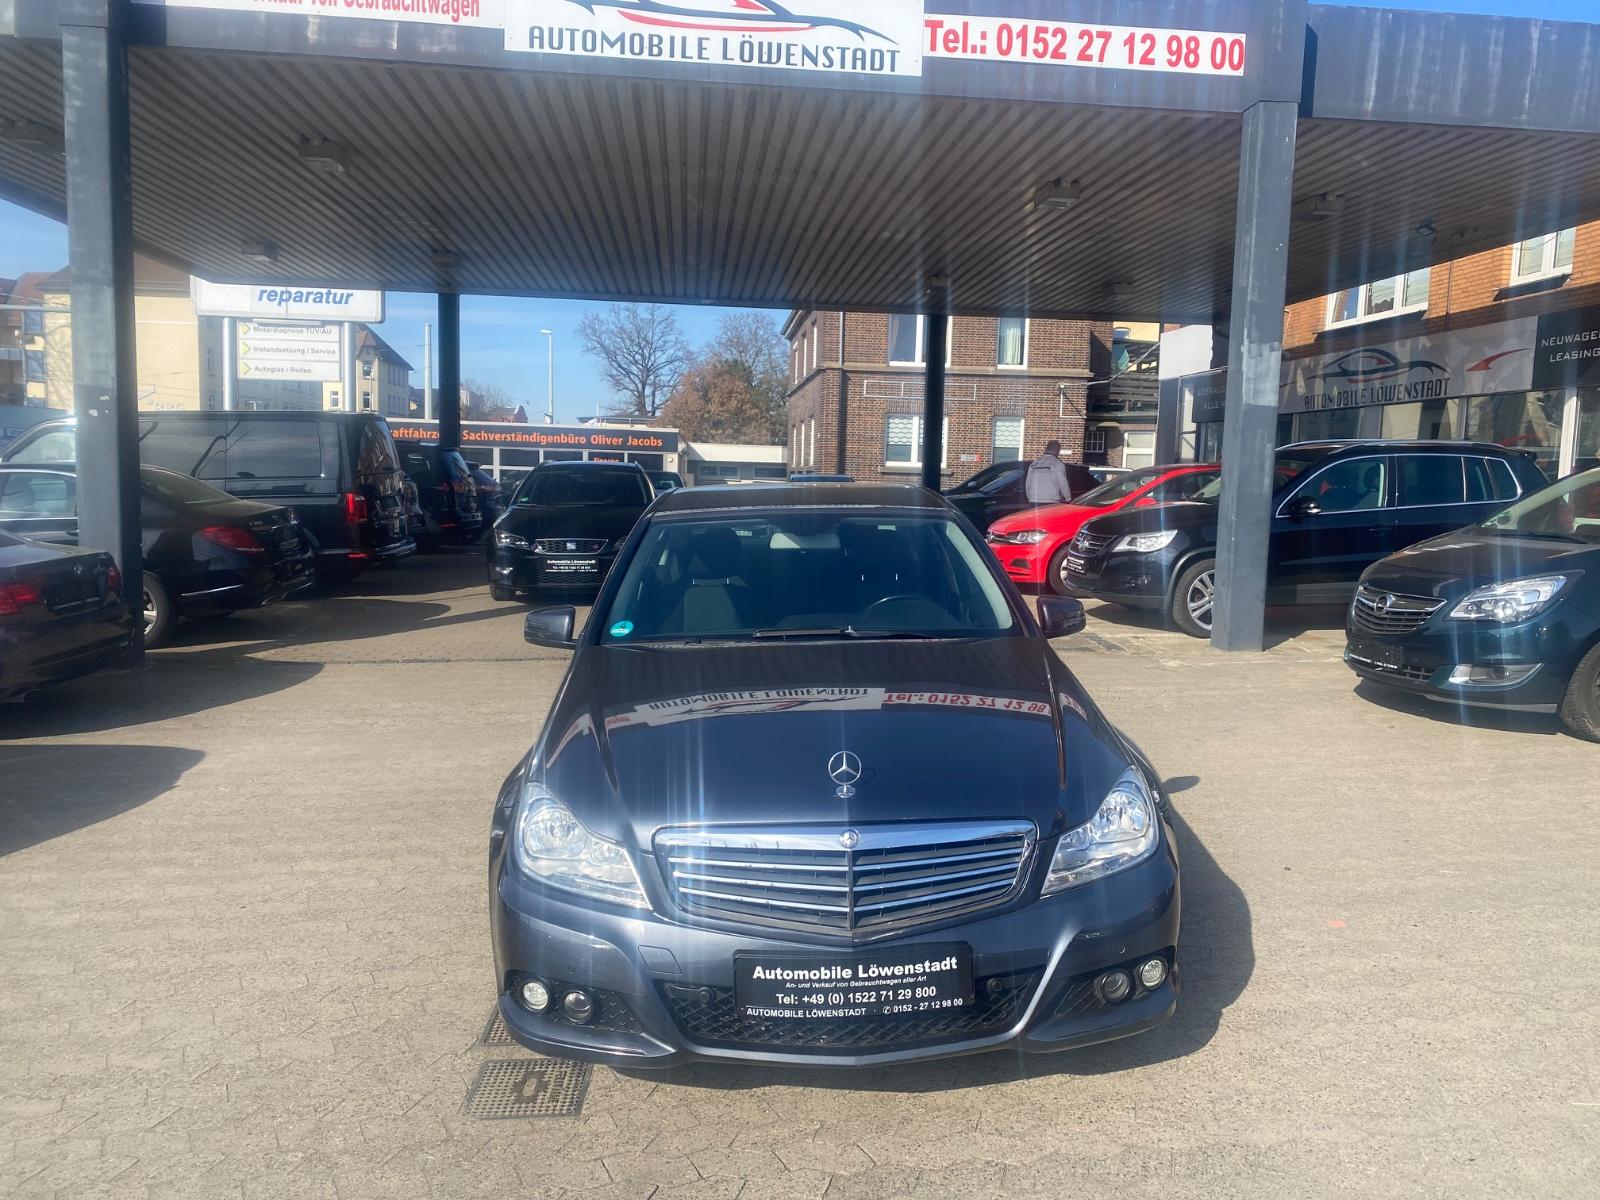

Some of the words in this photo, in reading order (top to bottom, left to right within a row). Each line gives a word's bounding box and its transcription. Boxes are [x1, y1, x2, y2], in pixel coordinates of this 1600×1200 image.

[528, 25, 710, 60] AUTOMOBILE
[722, 34, 901, 73] LÖWENSTADT
[924, 19, 987, 55] Tel.:
[996, 23, 1067, 60] 0152
[1077, 29, 1112, 63] 27
[1123, 32, 1156, 66] 12
[1166, 34, 1200, 69] 98
[1210, 37, 1244, 71] 00
[258, 287, 354, 306] reparatur
[1541, 331, 1600, 347] NEUWAGE
[310, 347, 336, 355] Service
[1550, 348, 1600, 362] LEASING
[1304, 387, 1367, 410] AUTOMOBILE
[1371, 378, 1451, 403] LÖWENSTADT
[462, 430, 586, 446] Sachverständigenbüro
[590, 434, 623, 446] Oliver
[626, 436, 662, 447] Jacobs
[752, 965, 853, 980] Automobile
[858, 956, 957, 978] Löwenstadt
[849, 978, 902, 987] Gebrauchtwagen
[776, 993, 798, 1004] Tel:
[802, 994, 824, 1004] +49
[828, 992, 844, 1005] (0)
[848, 992, 876, 1003] 1522
[880, 990, 893, 1001] 71
[897, 988, 912, 1000] 29
[915, 986, 936, 998] 800
[746, 1008, 804, 1018] AUTOMOBILE
[806, 1008, 867, 1018] LÖWENSTADT
[893, 1004, 913, 1013] 0152
[919, 1002, 929, 1010] 27
[931, 1001, 940, 1009] 12
[941, 999, 951, 1007] 98
[953, 998, 963, 1006] 00
